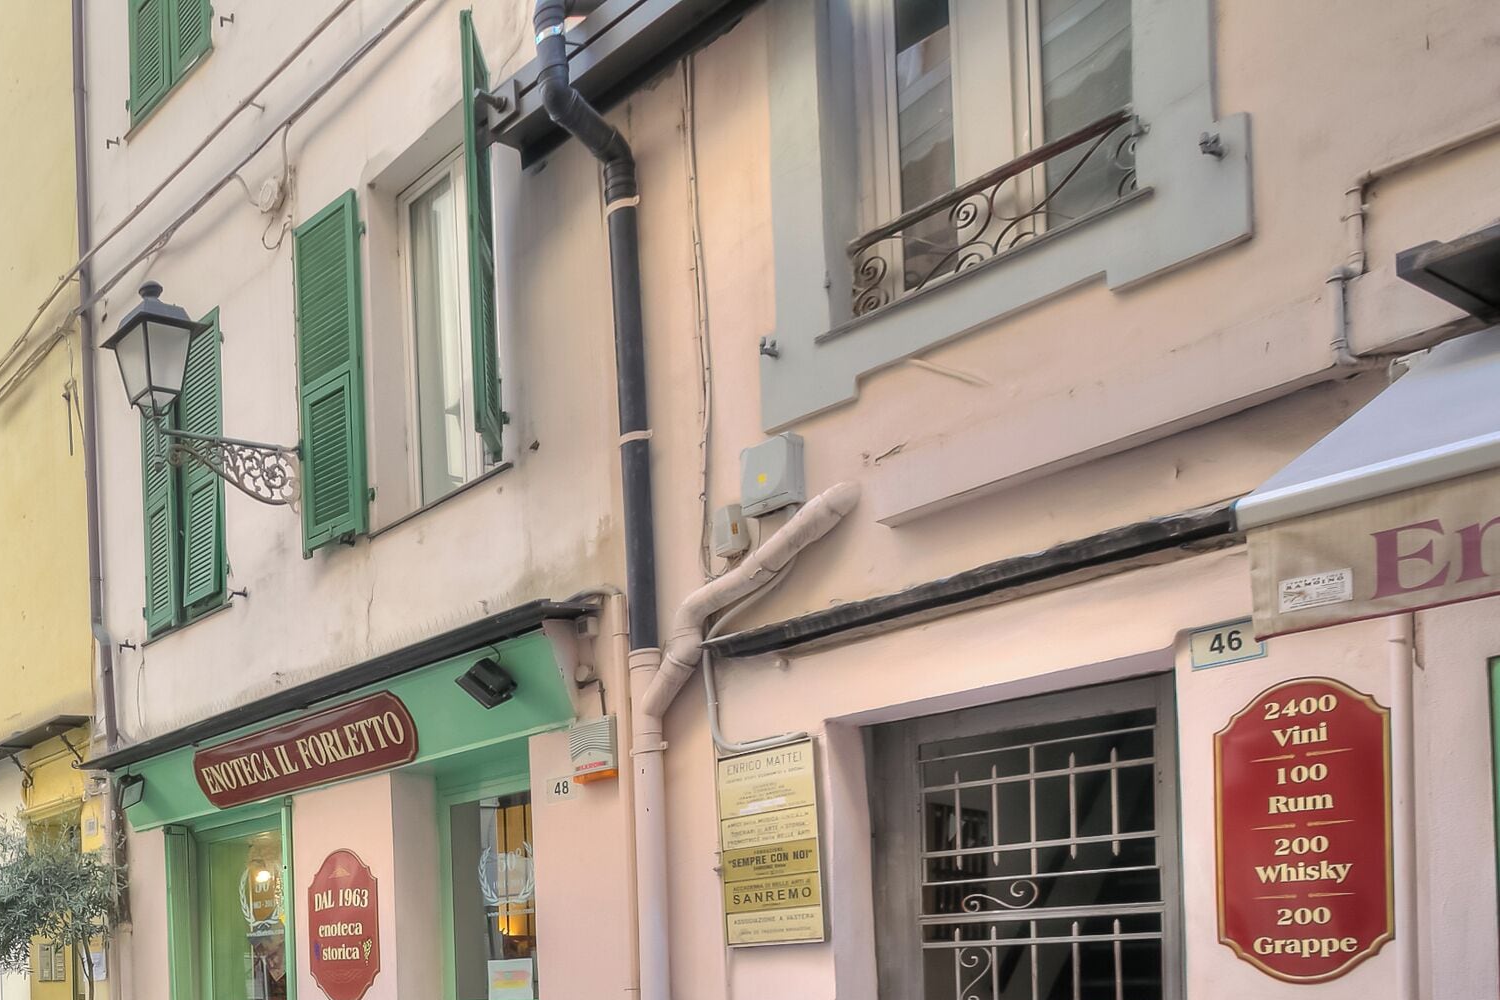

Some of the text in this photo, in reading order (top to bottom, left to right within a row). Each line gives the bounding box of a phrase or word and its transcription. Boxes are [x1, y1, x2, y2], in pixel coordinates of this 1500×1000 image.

[1209, 630, 1243, 654] 46
[1263, 694, 1338, 721] 2400
[1271, 721, 1328, 748] Vini
[201, 711, 405, 796] ENOTECA IL FORLETTO
[726, 759, 762, 776] ENRICO
[766, 751, 802, 768] MATTEI
[1277, 763, 1328, 785] 100
[554, 780, 569, 796] 48
[1268, 793, 1334, 815] Rum
[1274, 835, 1329, 856] 200
[770, 851, 789, 863] CON
[1254, 860, 1353, 884] Whisky
[315, 888, 369, 912] DAL 1963
[733, 887, 812, 905] SANREMO
[1276, 906, 1332, 926] 200
[319, 921, 363, 938] enoteca
[1253, 936, 1358, 958] Grappe
